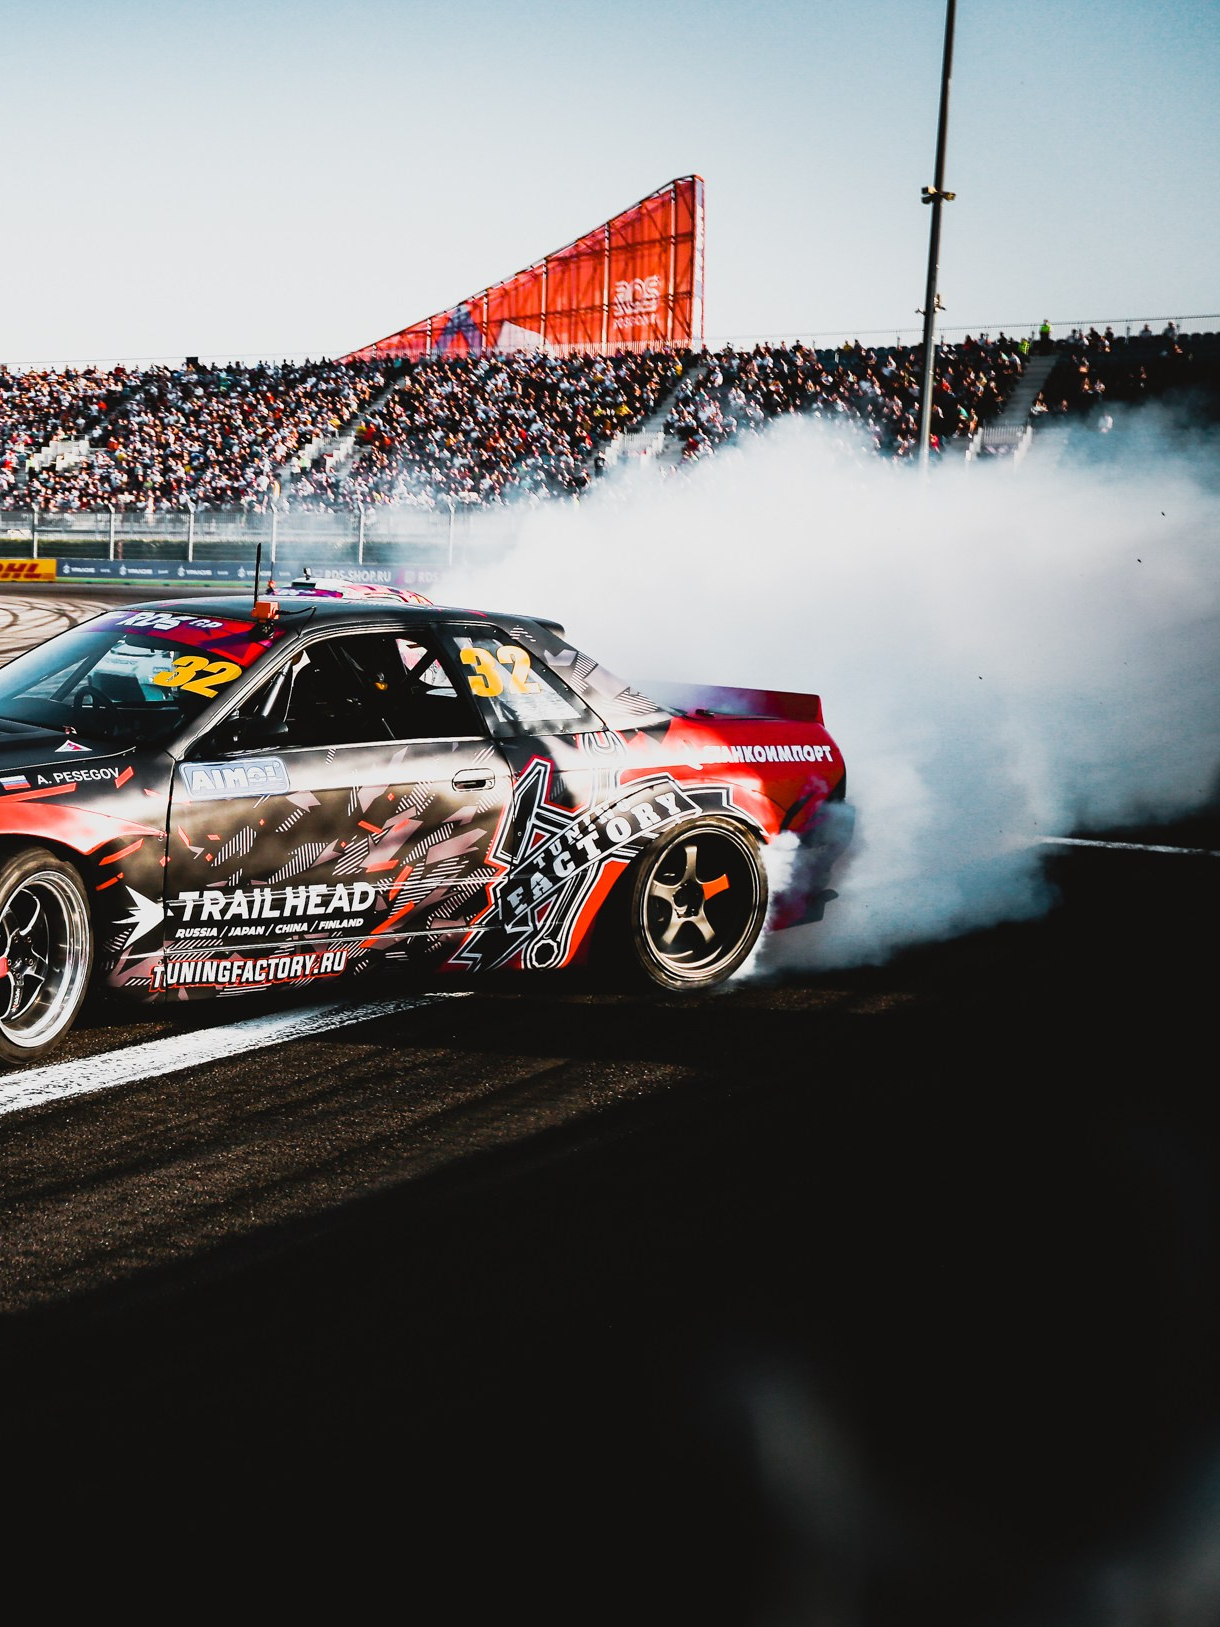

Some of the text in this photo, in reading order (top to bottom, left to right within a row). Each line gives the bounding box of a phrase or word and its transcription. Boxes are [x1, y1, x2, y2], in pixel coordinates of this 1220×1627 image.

[116, 612, 196, 631] RDS
[153, 655, 243, 699] 32
[460, 645, 540, 698] 32
[37, 767, 119, 785] A. PESEGOV
[191, 765, 284, 791] AIMOL
[506, 791, 682, 916] FACTORY
[178, 882, 376, 922] TRAILHEAD
[175, 927, 218, 939] RUSSIA
[228, 925, 265, 937] JAPAN
[275, 922, 308, 934] CHINA
[318, 918, 364, 931] FINLAND
[153, 950, 349, 988] TUNINGFACTORY.RU
